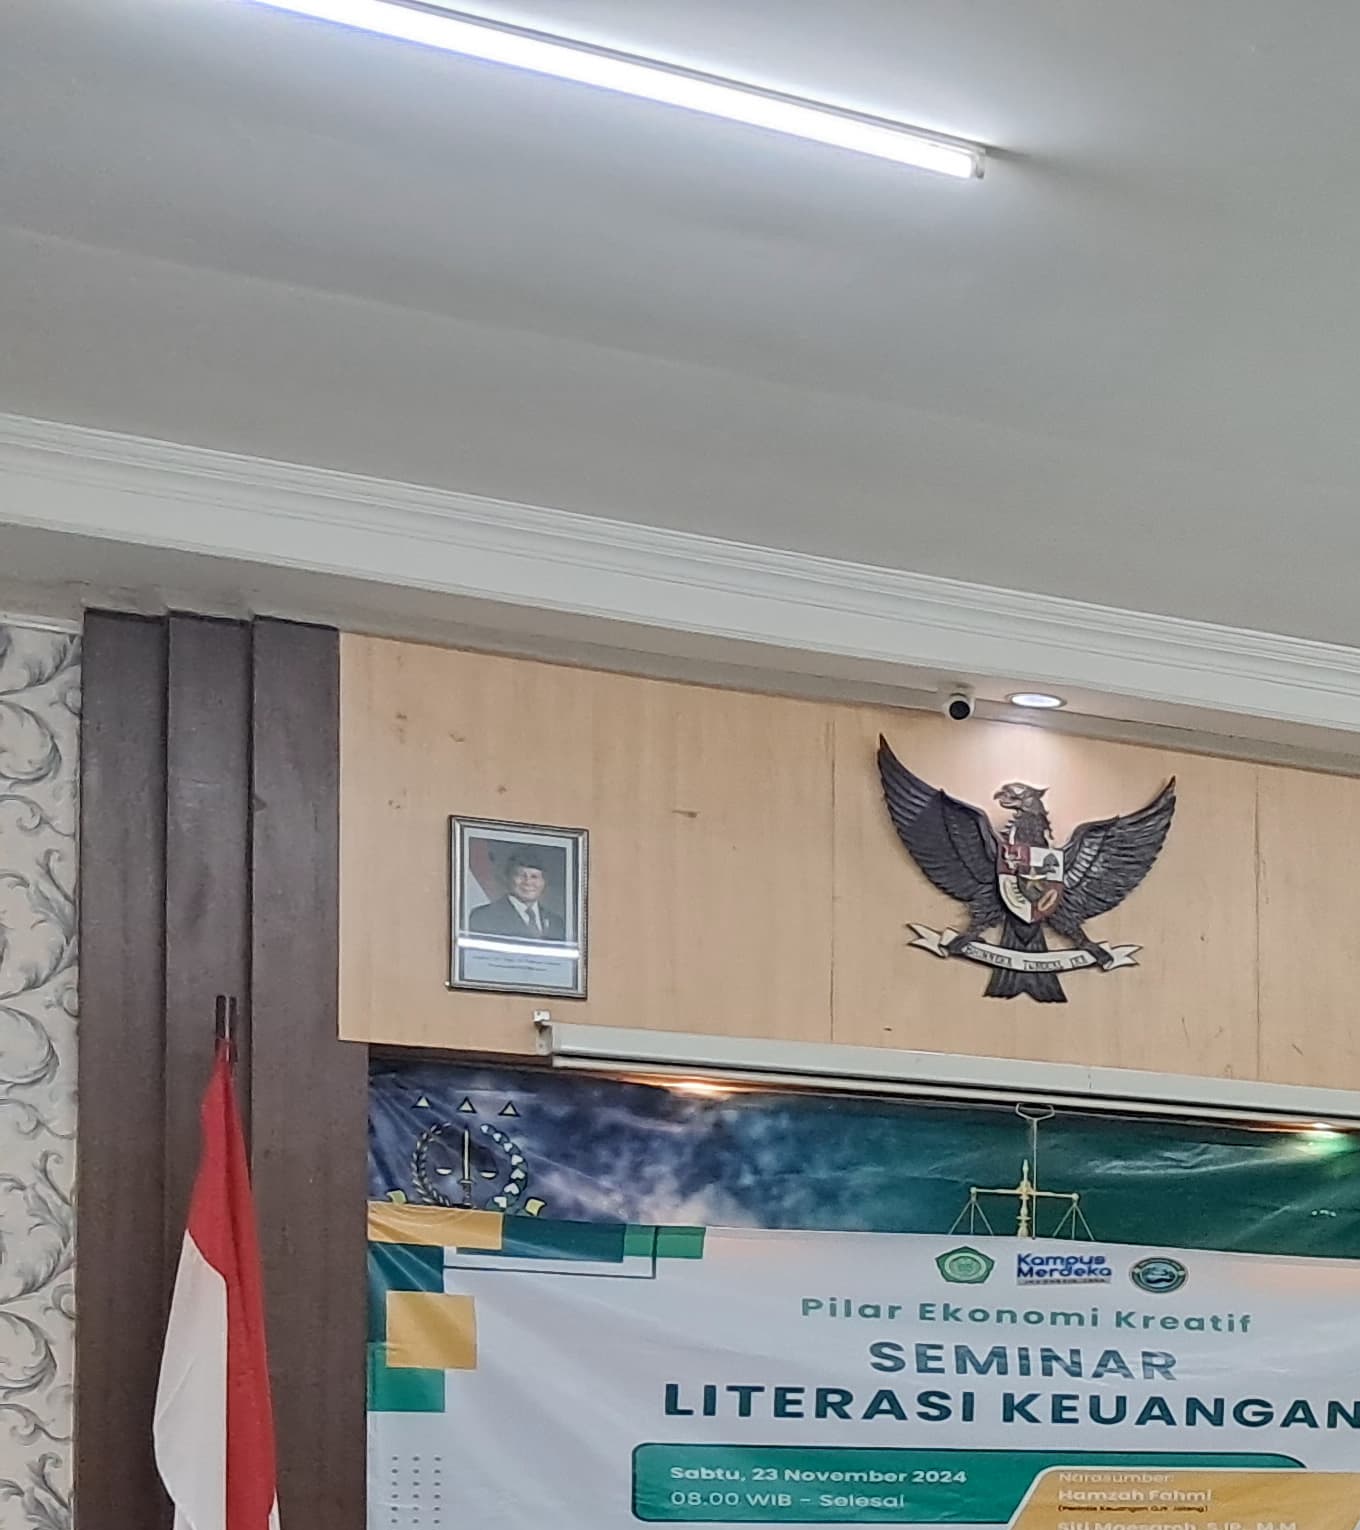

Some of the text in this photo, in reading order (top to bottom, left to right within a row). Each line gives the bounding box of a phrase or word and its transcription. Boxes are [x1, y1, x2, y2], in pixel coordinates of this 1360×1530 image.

[1017, 1253, 1106, 1268] Kampus
[1017, 1265, 1112, 1278] Merdeka
[801, 1297, 1253, 1333] Pilar Ekonomi Kreatif
[869, 1341, 1177, 1381] SEMINAR
[664, 1383, 975, 1422] LITERASI
[670, 1466, 967, 1483] Sabtu, 23 November 2024
[670, 1491, 739, 1507] 08.00
[745, 1492, 792, 1507] WIB
[819, 1493, 905, 1508] Selesai
[1058, 1489, 1212, 1501] Hamzah Fahmi
